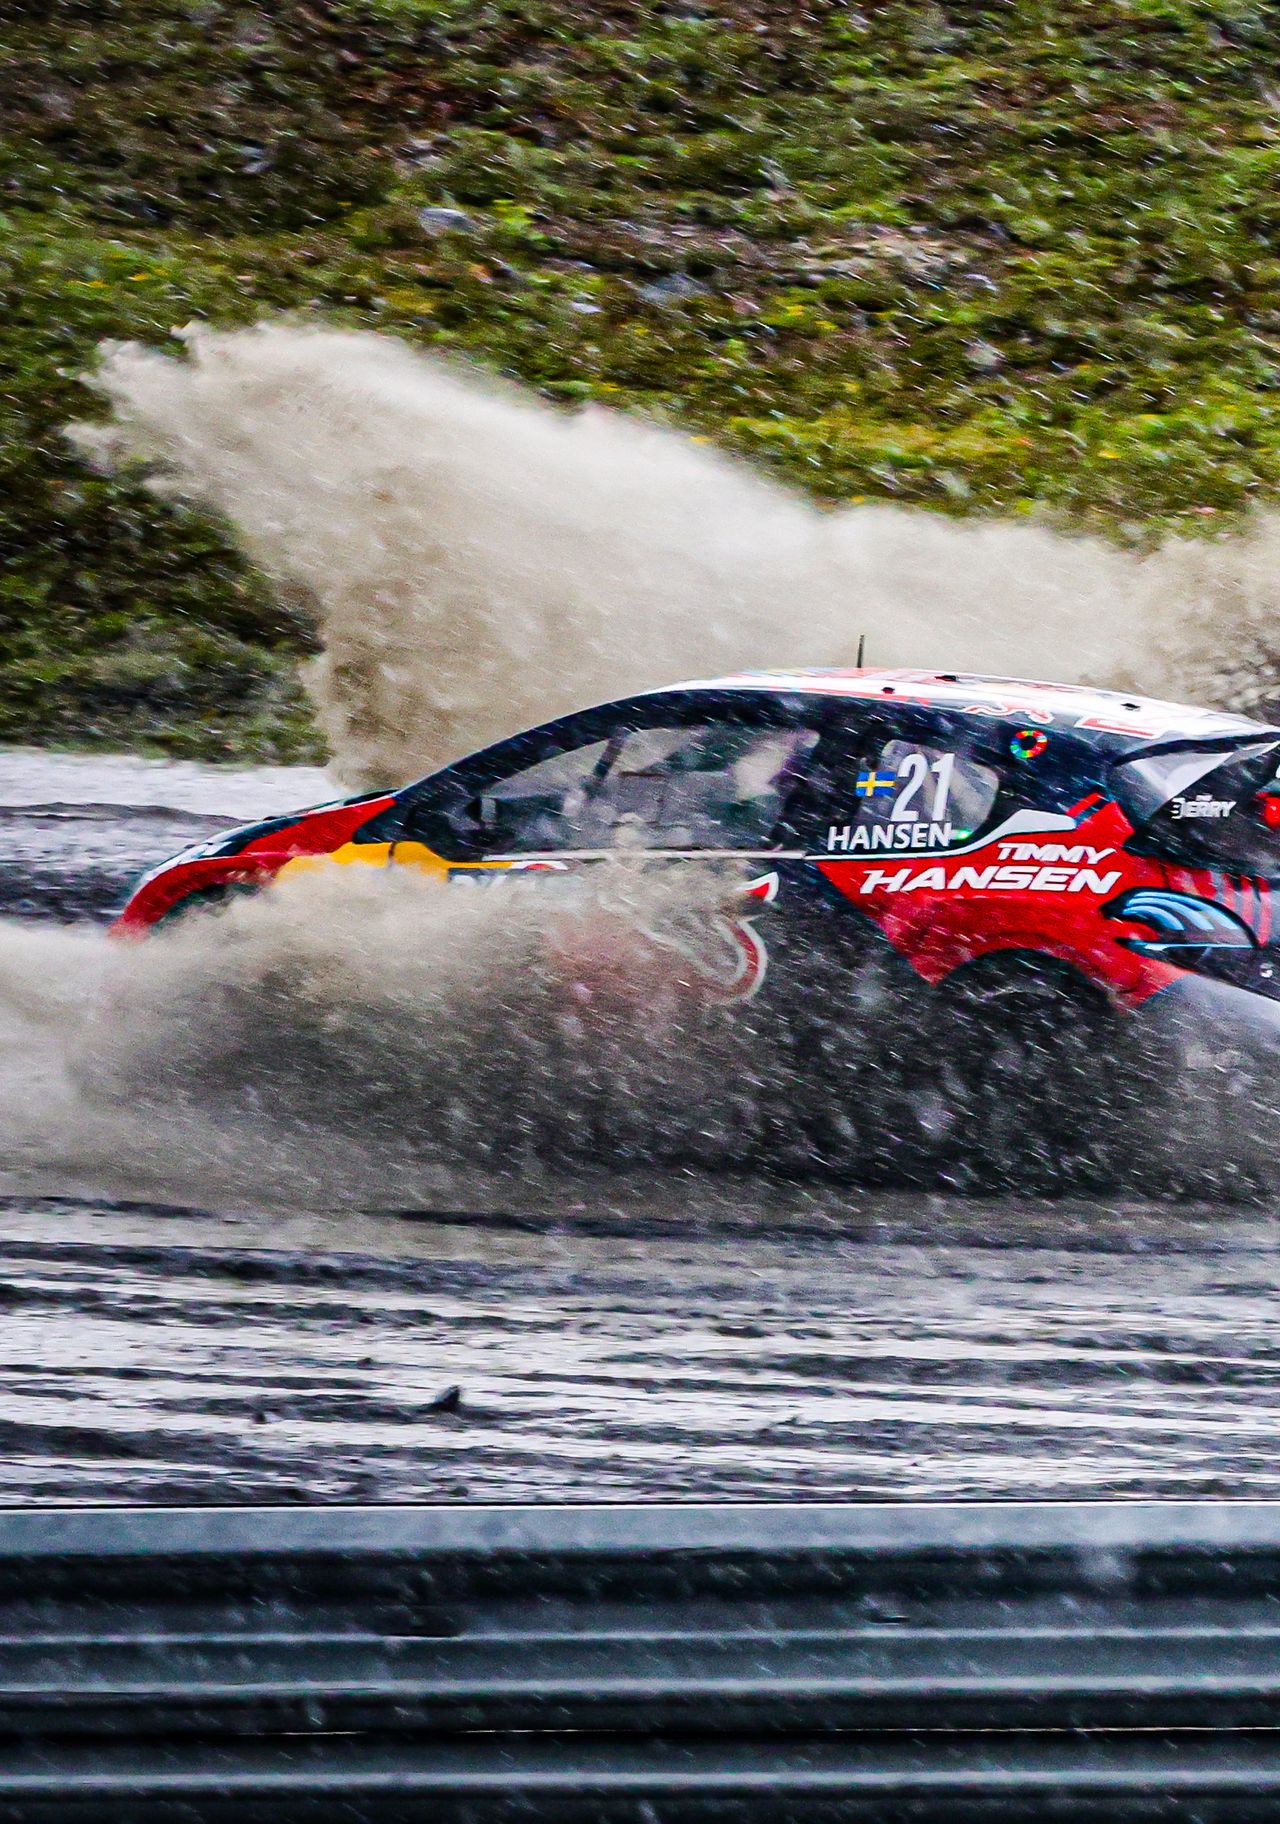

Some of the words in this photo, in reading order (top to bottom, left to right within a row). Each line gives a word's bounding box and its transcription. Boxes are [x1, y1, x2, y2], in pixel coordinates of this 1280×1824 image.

[890, 753, 955, 822] 21
[827, 823, 952, 851] HANSEN
[997, 842, 1117, 865] TIMMY
[859, 865, 1122, 894] HANSEN
